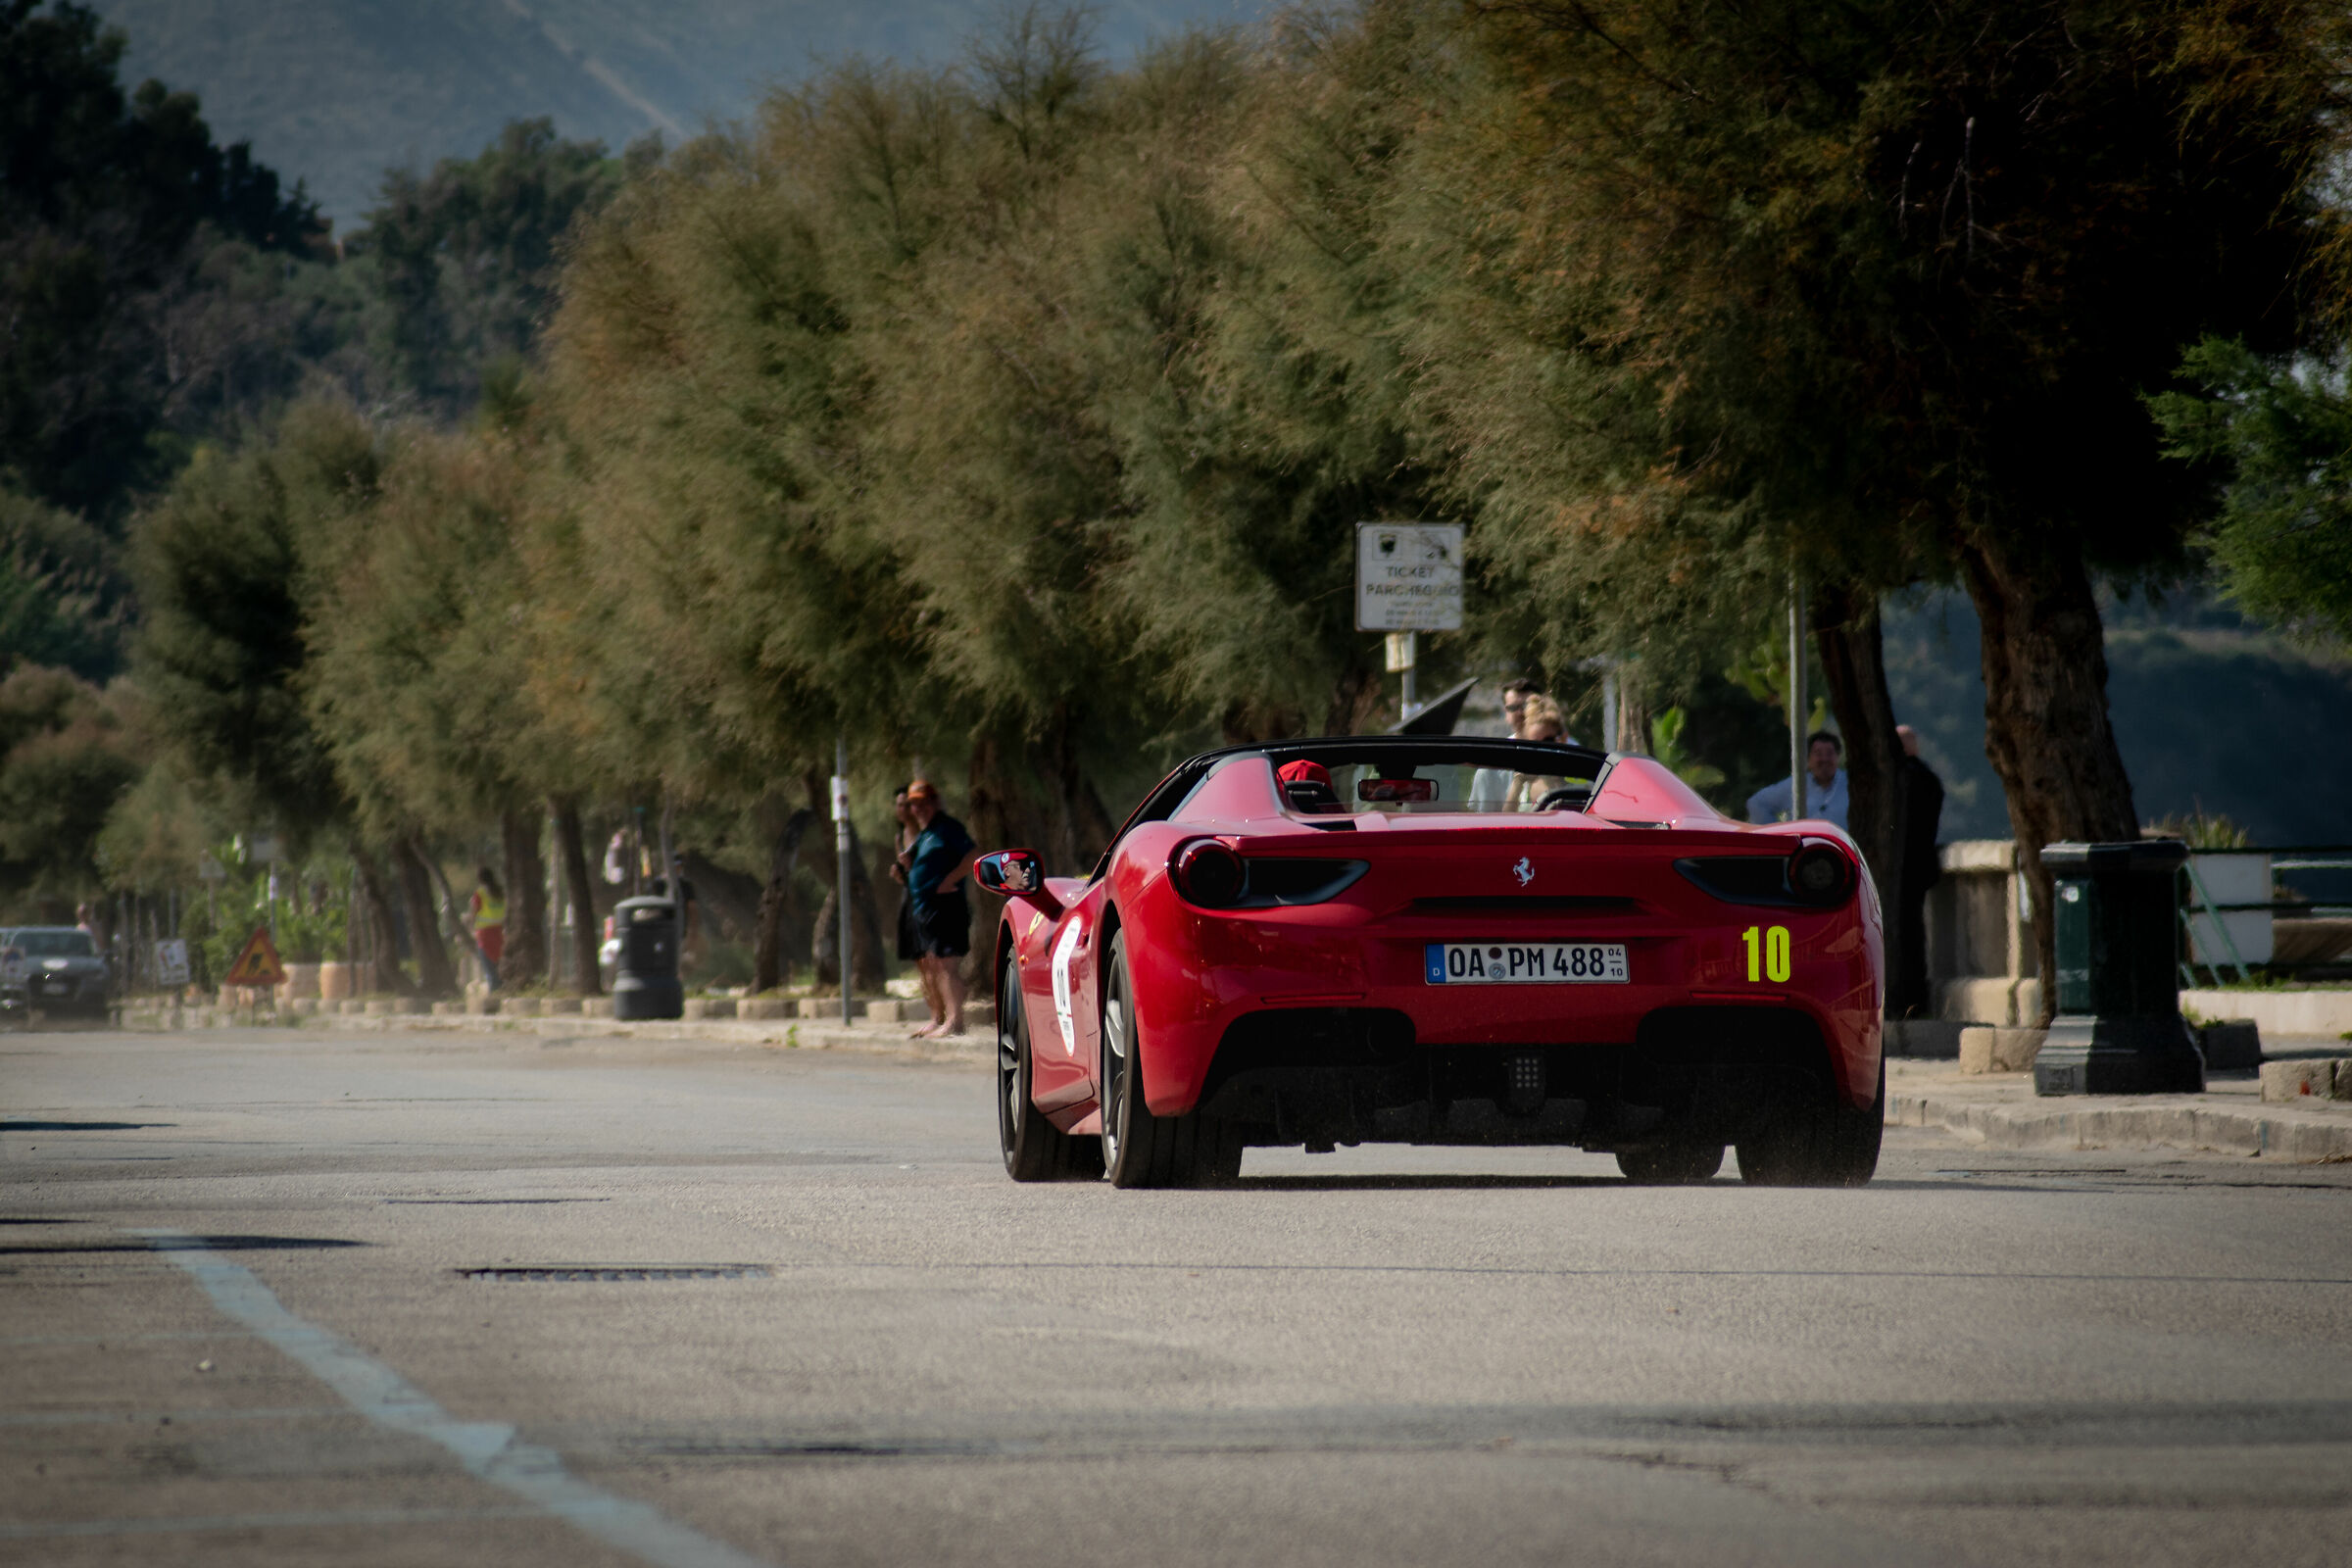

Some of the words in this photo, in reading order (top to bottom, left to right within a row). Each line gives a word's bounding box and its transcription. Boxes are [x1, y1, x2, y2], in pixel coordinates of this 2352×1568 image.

[1386, 565, 1435, 578] TICKET
[1608, 948, 1622, 956] 04
[1742, 925, 1790, 983] 10
[1448, 947, 1485, 977] OA
[1507, 948, 1544, 977] PM
[1552, 947, 1605, 977] 488
[1433, 968, 1441, 977] D
[1610, 967, 1623, 977] 10
